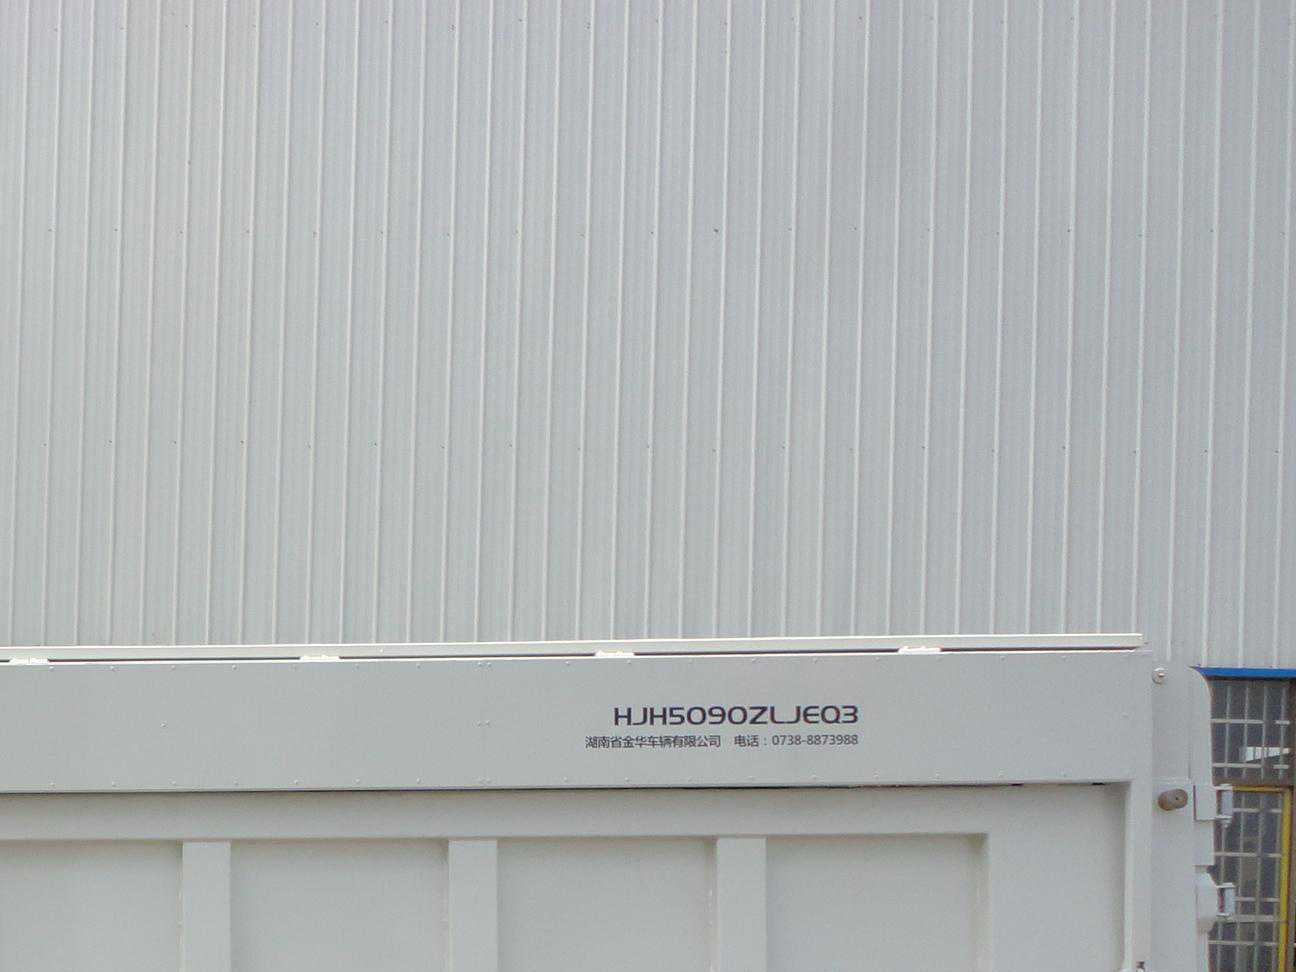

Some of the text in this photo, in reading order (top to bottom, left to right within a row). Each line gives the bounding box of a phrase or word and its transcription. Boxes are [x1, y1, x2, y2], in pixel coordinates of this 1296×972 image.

[613, 705, 859, 726] HJH5090ZLJEQ3
[584, 734, 722, 749] 湖南省金华车辆有限公司
